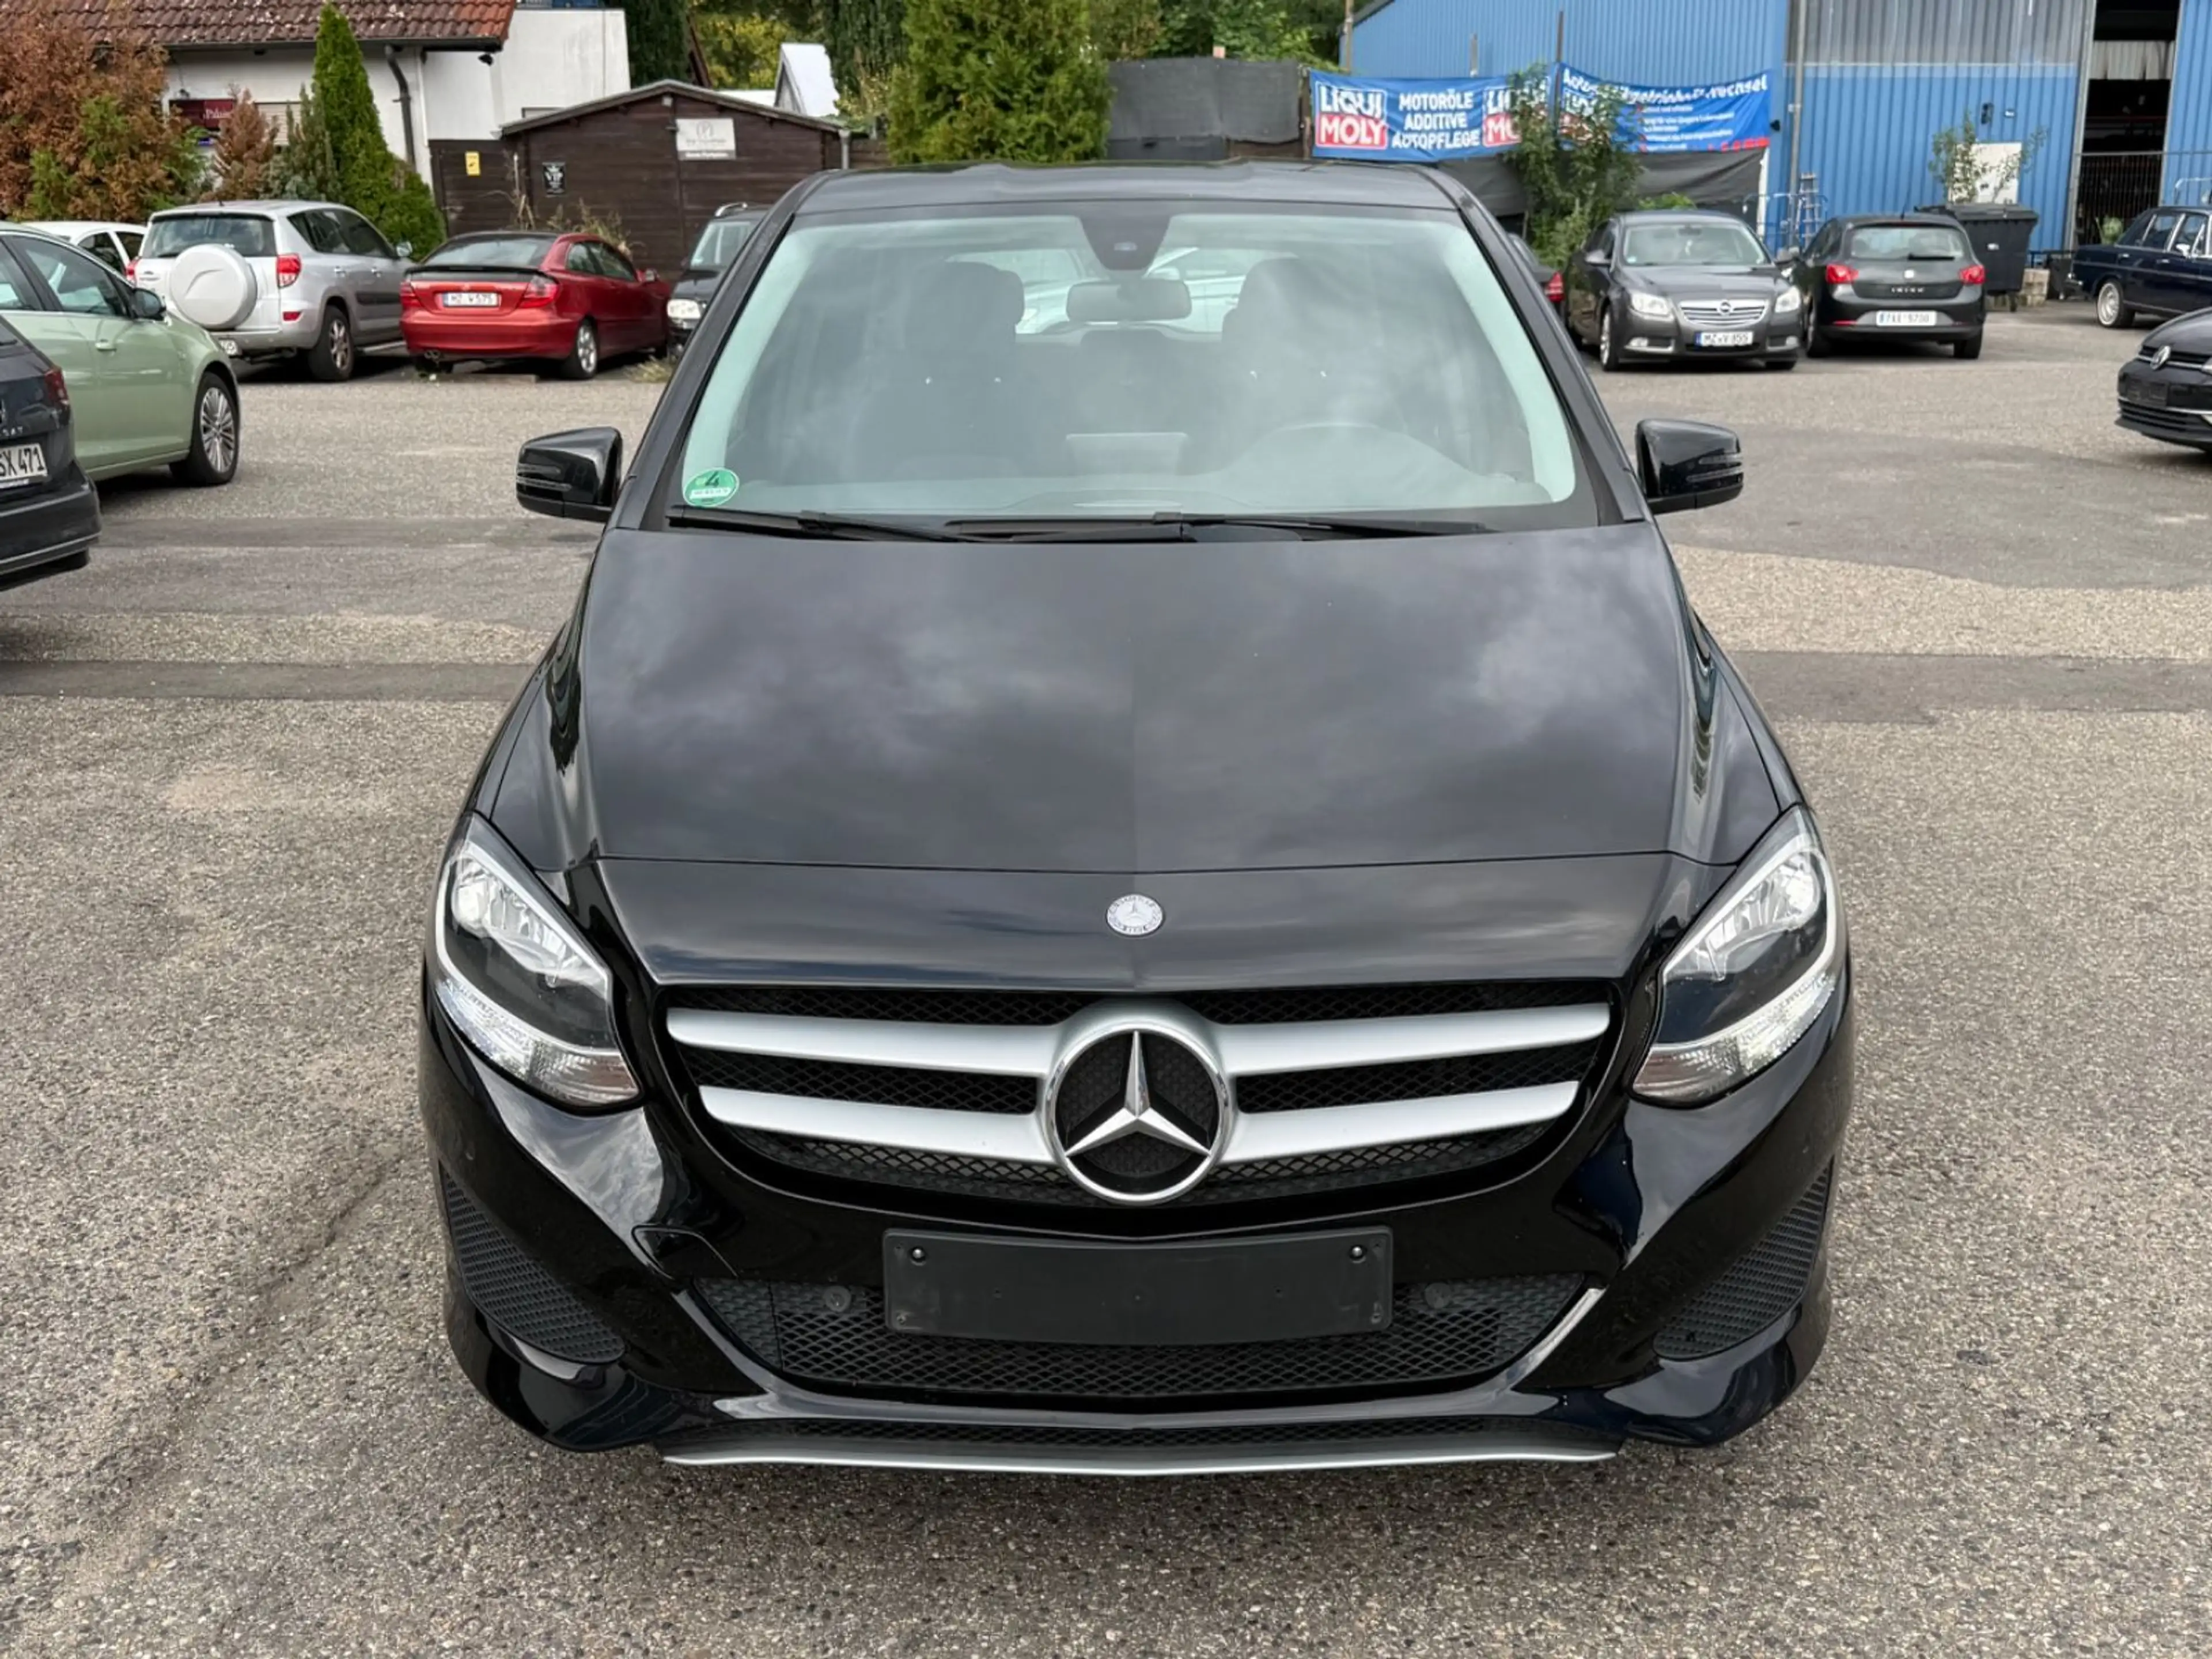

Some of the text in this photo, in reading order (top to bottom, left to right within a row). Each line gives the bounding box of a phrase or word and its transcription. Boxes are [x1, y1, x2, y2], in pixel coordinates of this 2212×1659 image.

[1320, 86, 1382, 119] LIQUI
[1398, 88, 1475, 111] MOTORÖLE
[1320, 115, 1384, 145] MOLY
[1404, 112, 1468, 130] ADDITIVE
[1391, 128, 1480, 149] AUTOPFLEGE
[18, 446, 45, 474] 471
[704, 471, 719, 488] 4
